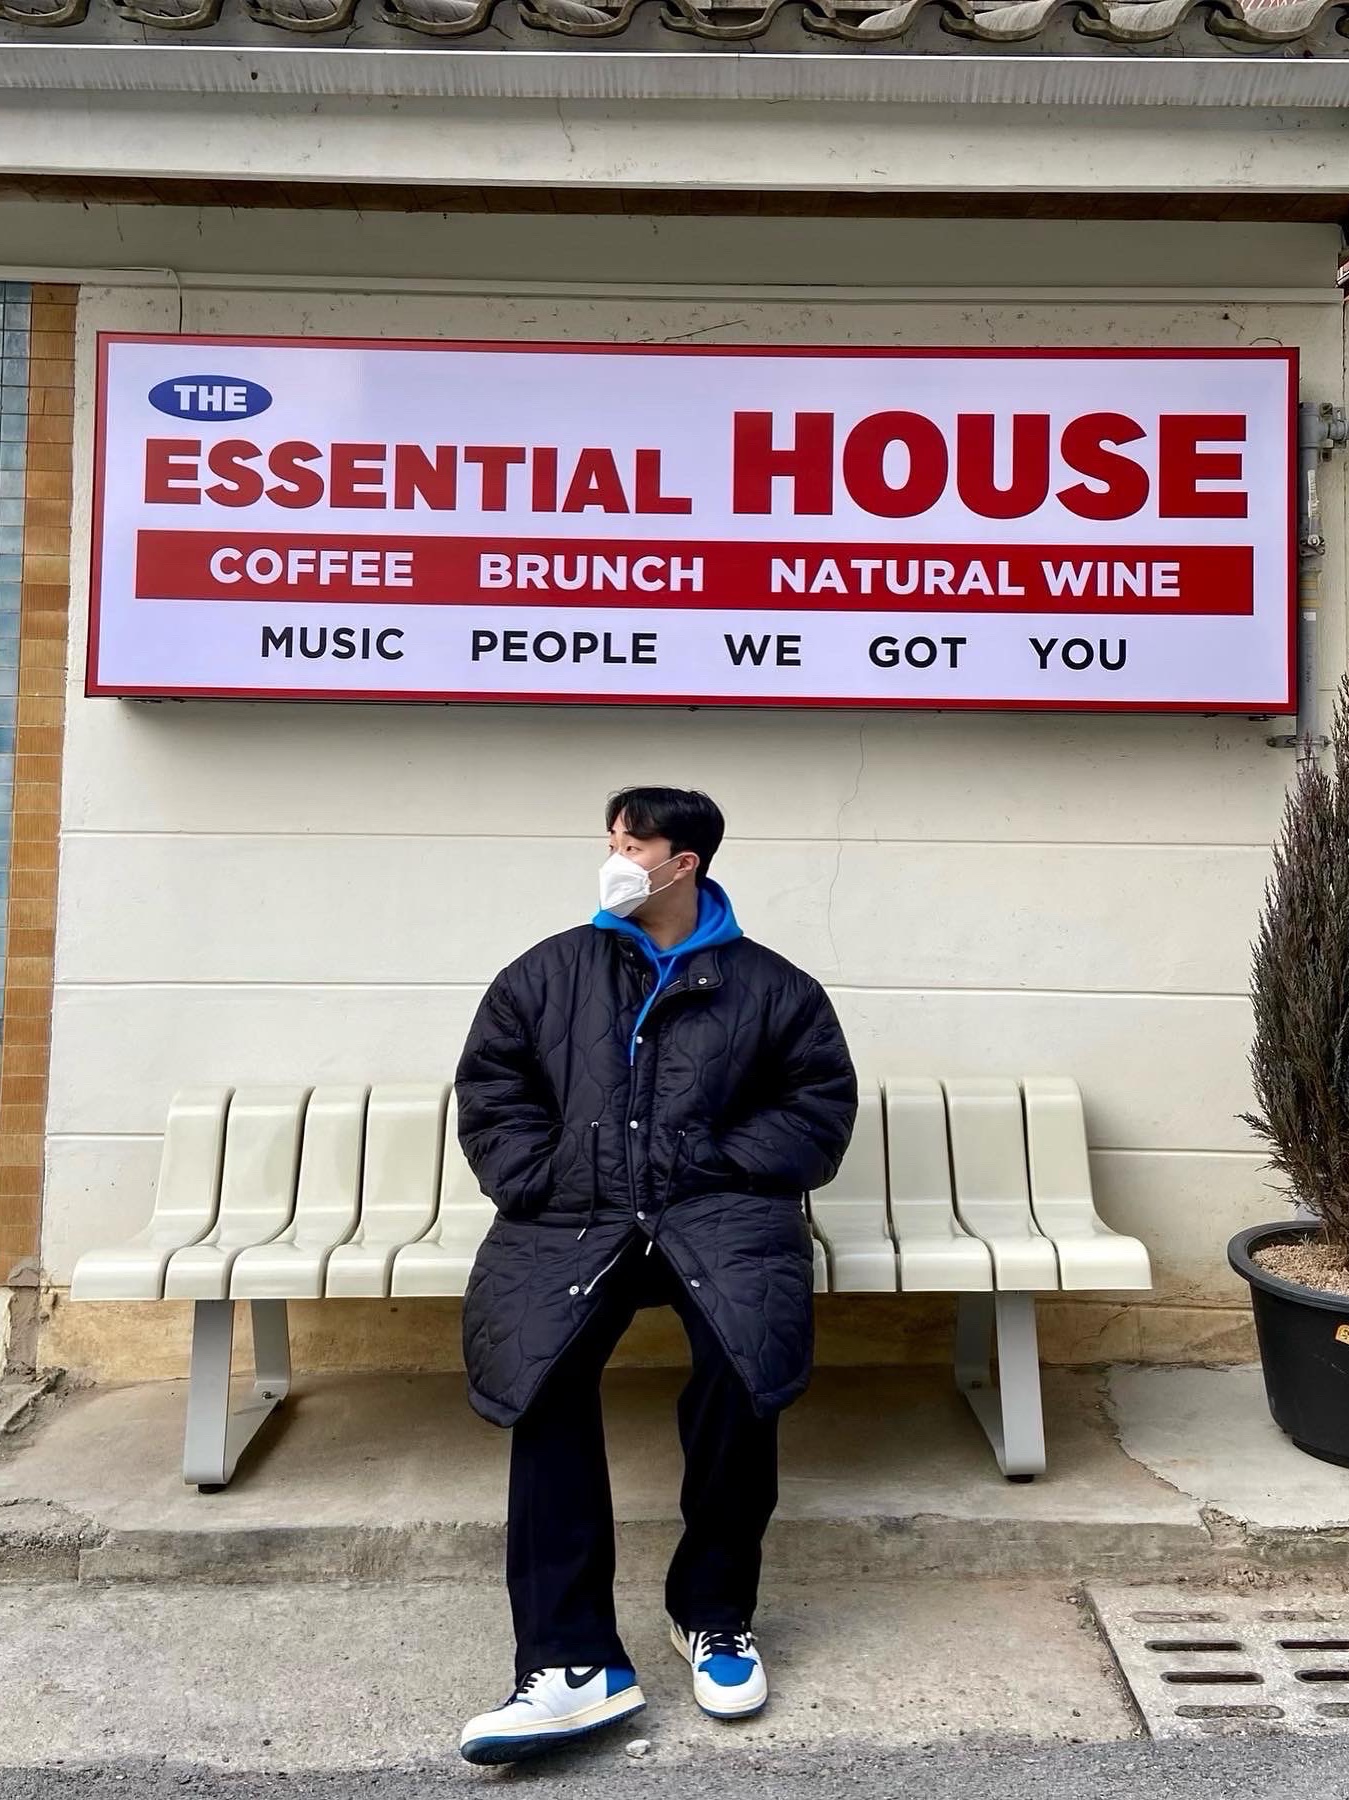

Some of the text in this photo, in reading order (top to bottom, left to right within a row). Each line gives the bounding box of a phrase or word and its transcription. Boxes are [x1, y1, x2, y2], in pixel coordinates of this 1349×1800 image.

[173, 384, 248, 413] THE
[144, 410, 1248, 520] ESSENTIAL HOUSE
[210, 548, 1179, 596] COFFEE BRUNCH NATURAL WINE
[262, 627, 1126, 670] MUSIC PEOPLE WE GOT YOU
